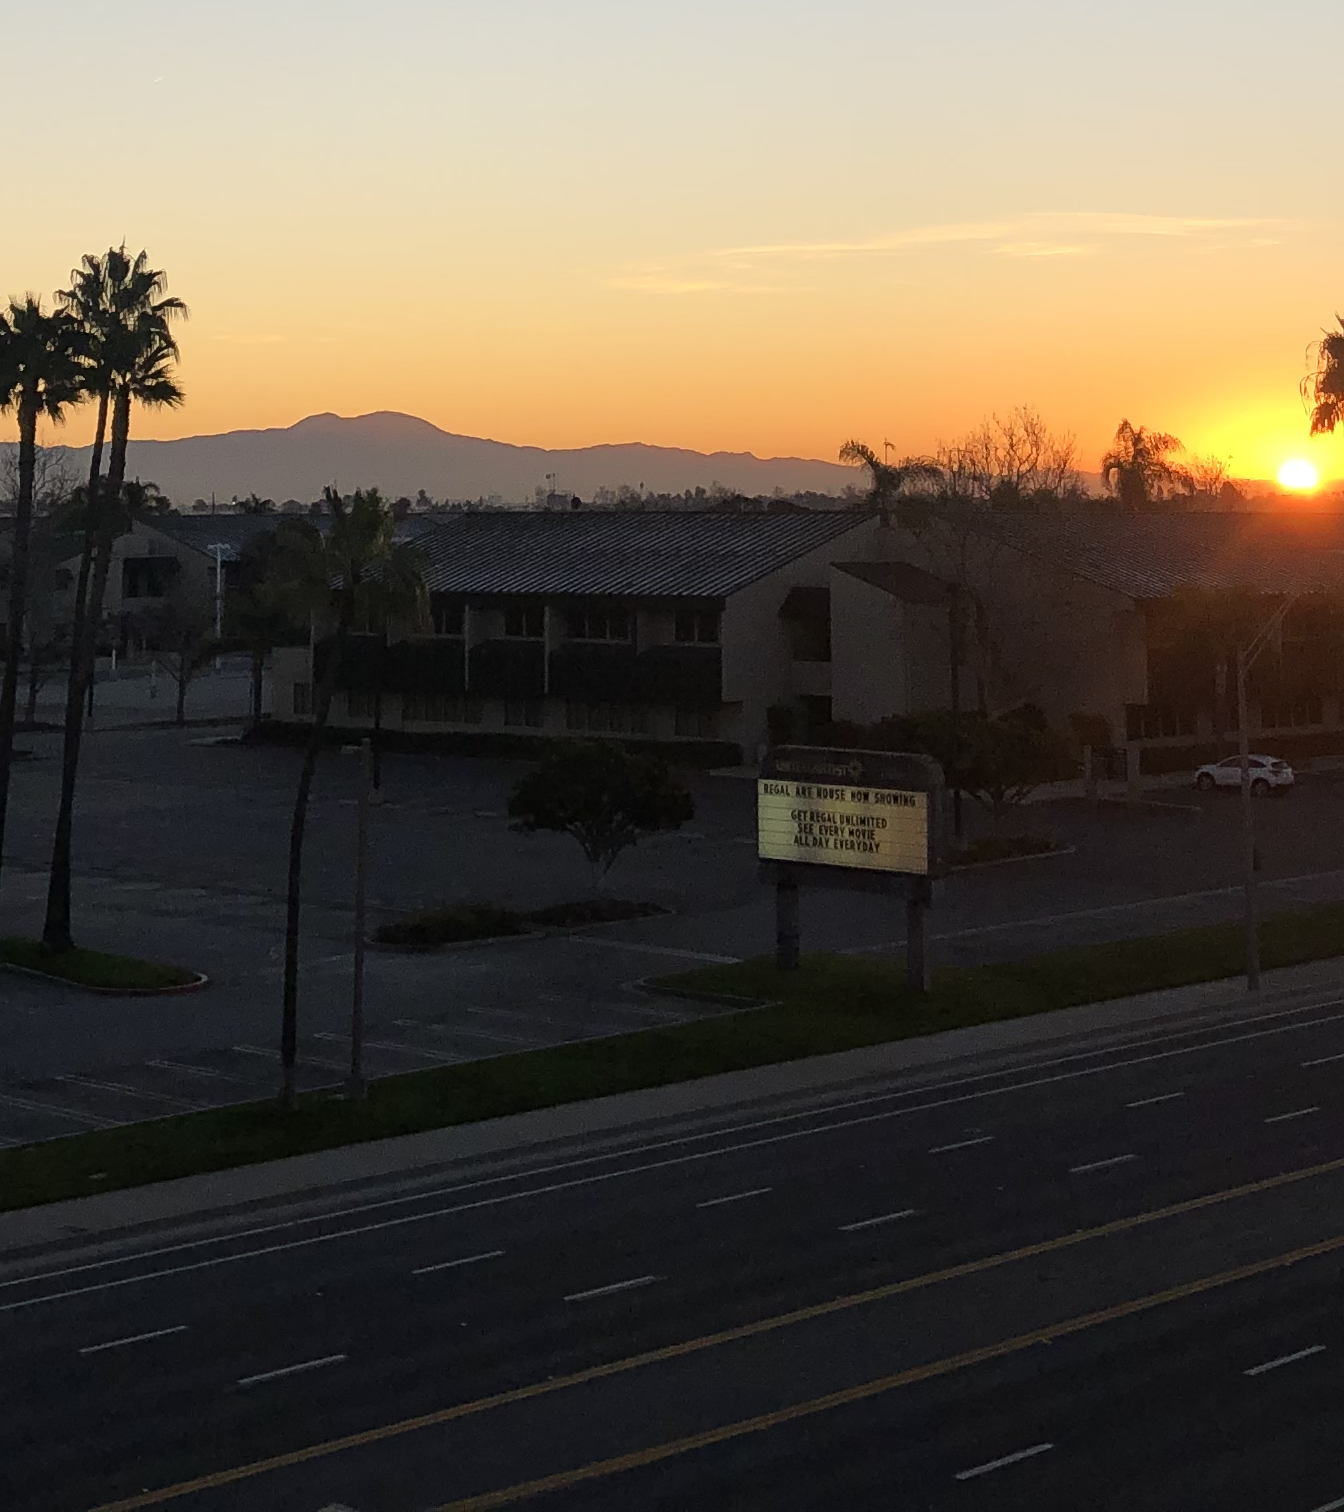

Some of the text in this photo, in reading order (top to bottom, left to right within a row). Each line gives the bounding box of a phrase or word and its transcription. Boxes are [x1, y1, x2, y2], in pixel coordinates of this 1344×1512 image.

[763, 783, 916, 807] REGAL ART HOUSE NOW SHOWING
[790, 809, 888, 829] GET REGAL UNLIMITED
[797, 823, 876, 840] SEE EVERY MOVIE
[793, 835, 880, 853] ALL DAY EVERYDAY
